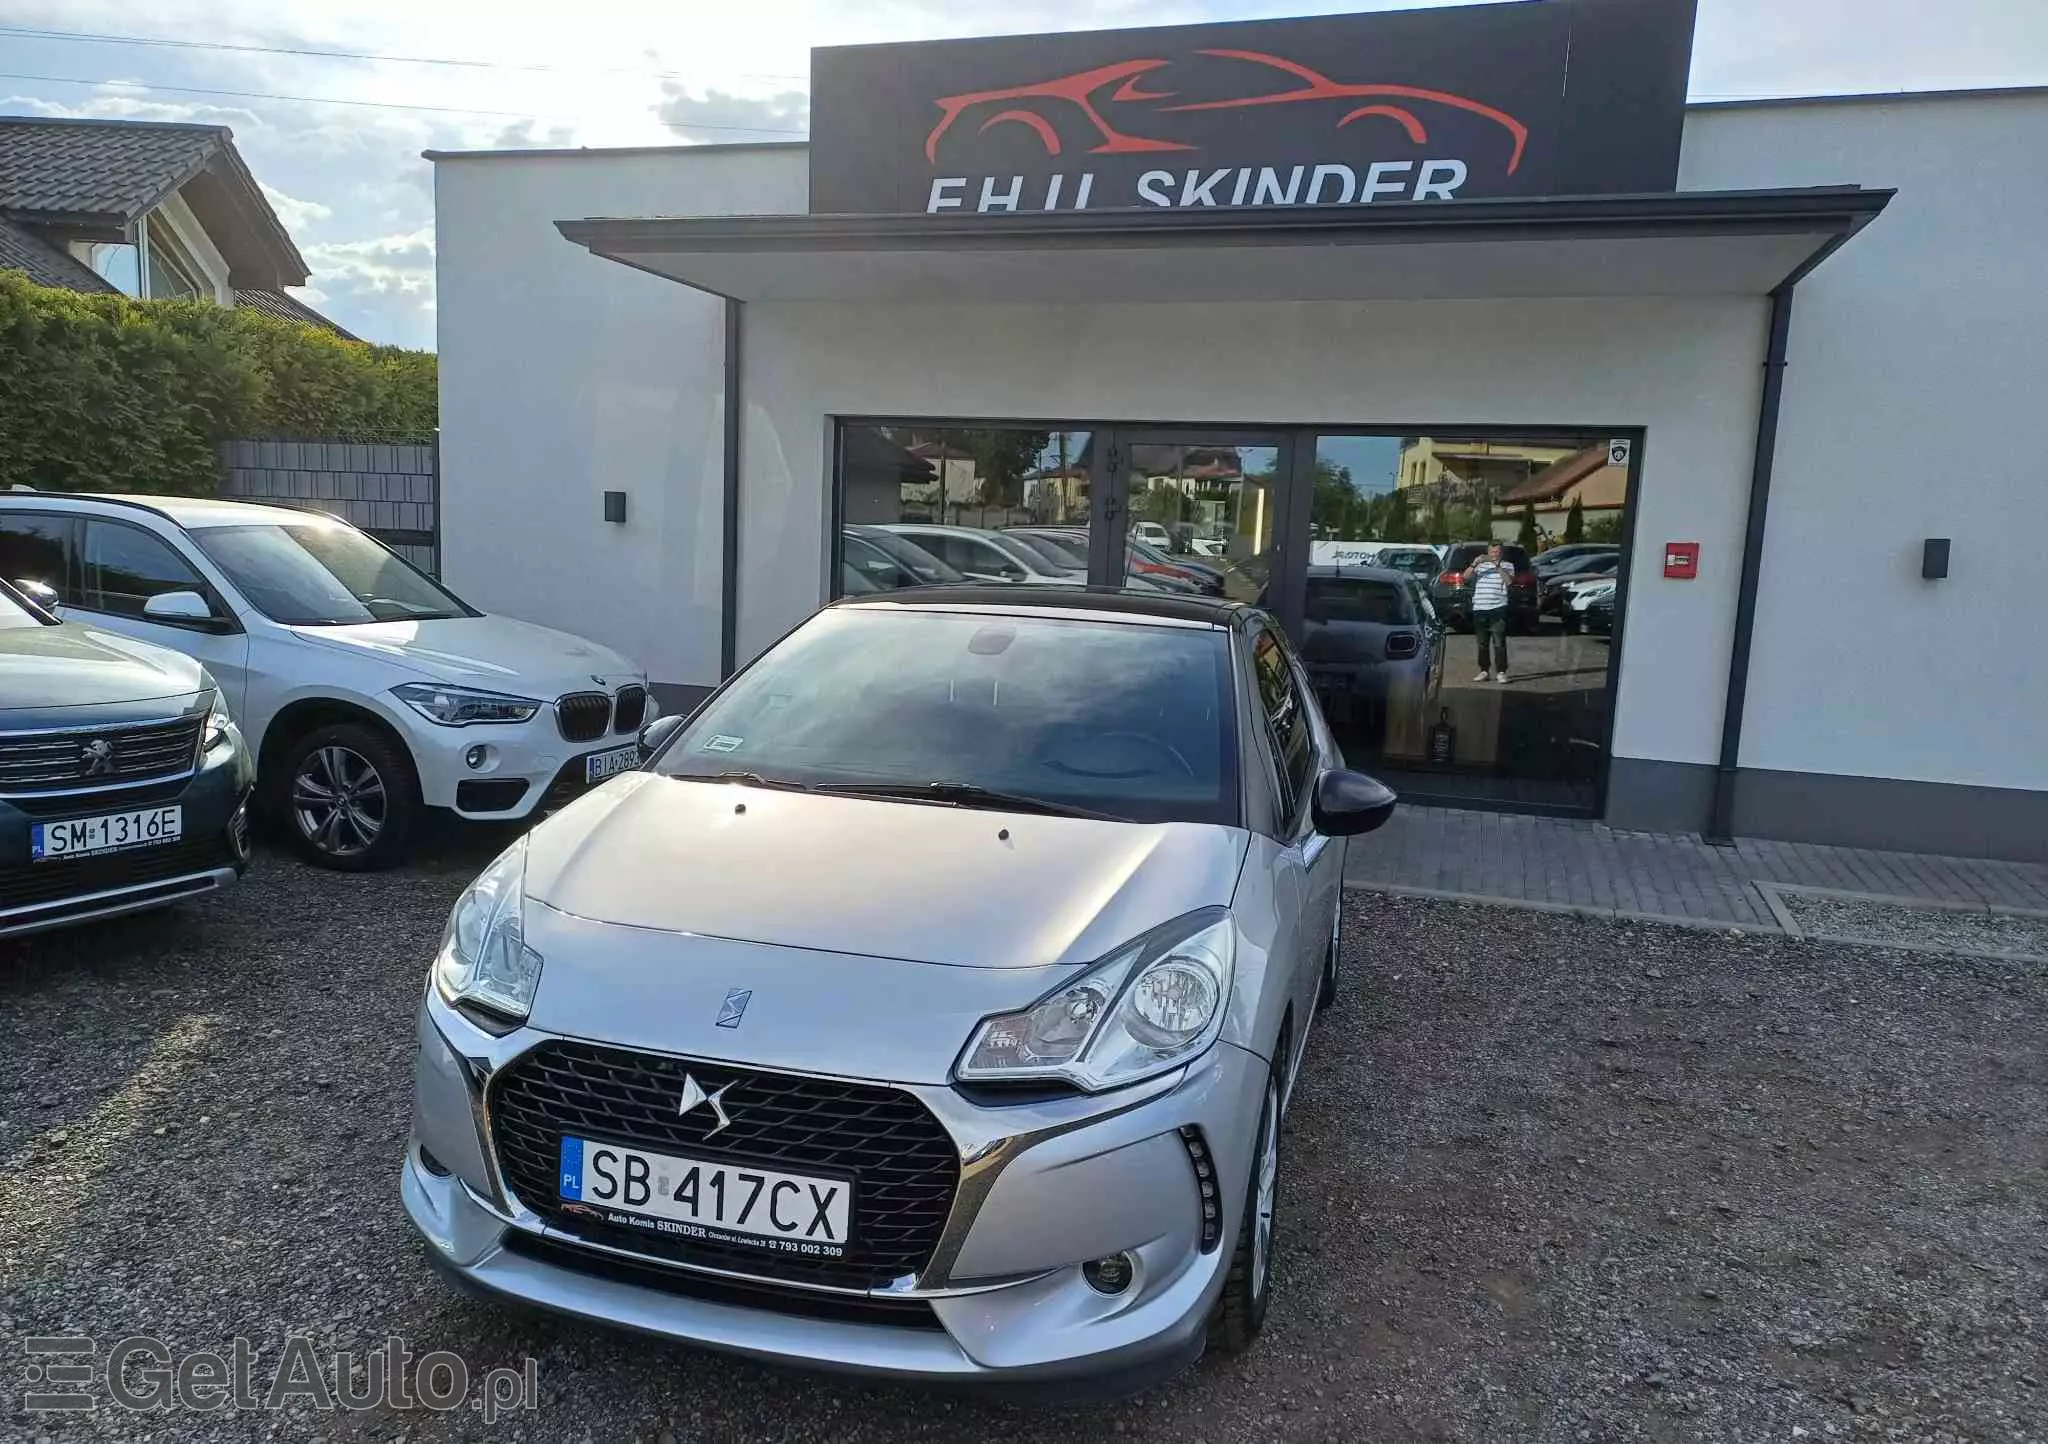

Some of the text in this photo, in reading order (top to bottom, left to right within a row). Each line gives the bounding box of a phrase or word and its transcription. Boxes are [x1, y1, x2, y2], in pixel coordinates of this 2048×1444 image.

[595, 755, 615, 776] BIA
[51, 822, 88, 852] SM
[100, 809, 175, 845] 1316E
[563, 1174, 580, 1189] PL
[592, 1150, 838, 1240] SB 417CX
[608, 1213, 627, 1225] Auto
[657, 1220, 707, 1239] SKINDER
[779, 1241, 798, 1252] 793
[801, 1243, 820, 1254] 002
[823, 1246, 843, 1257] 309
